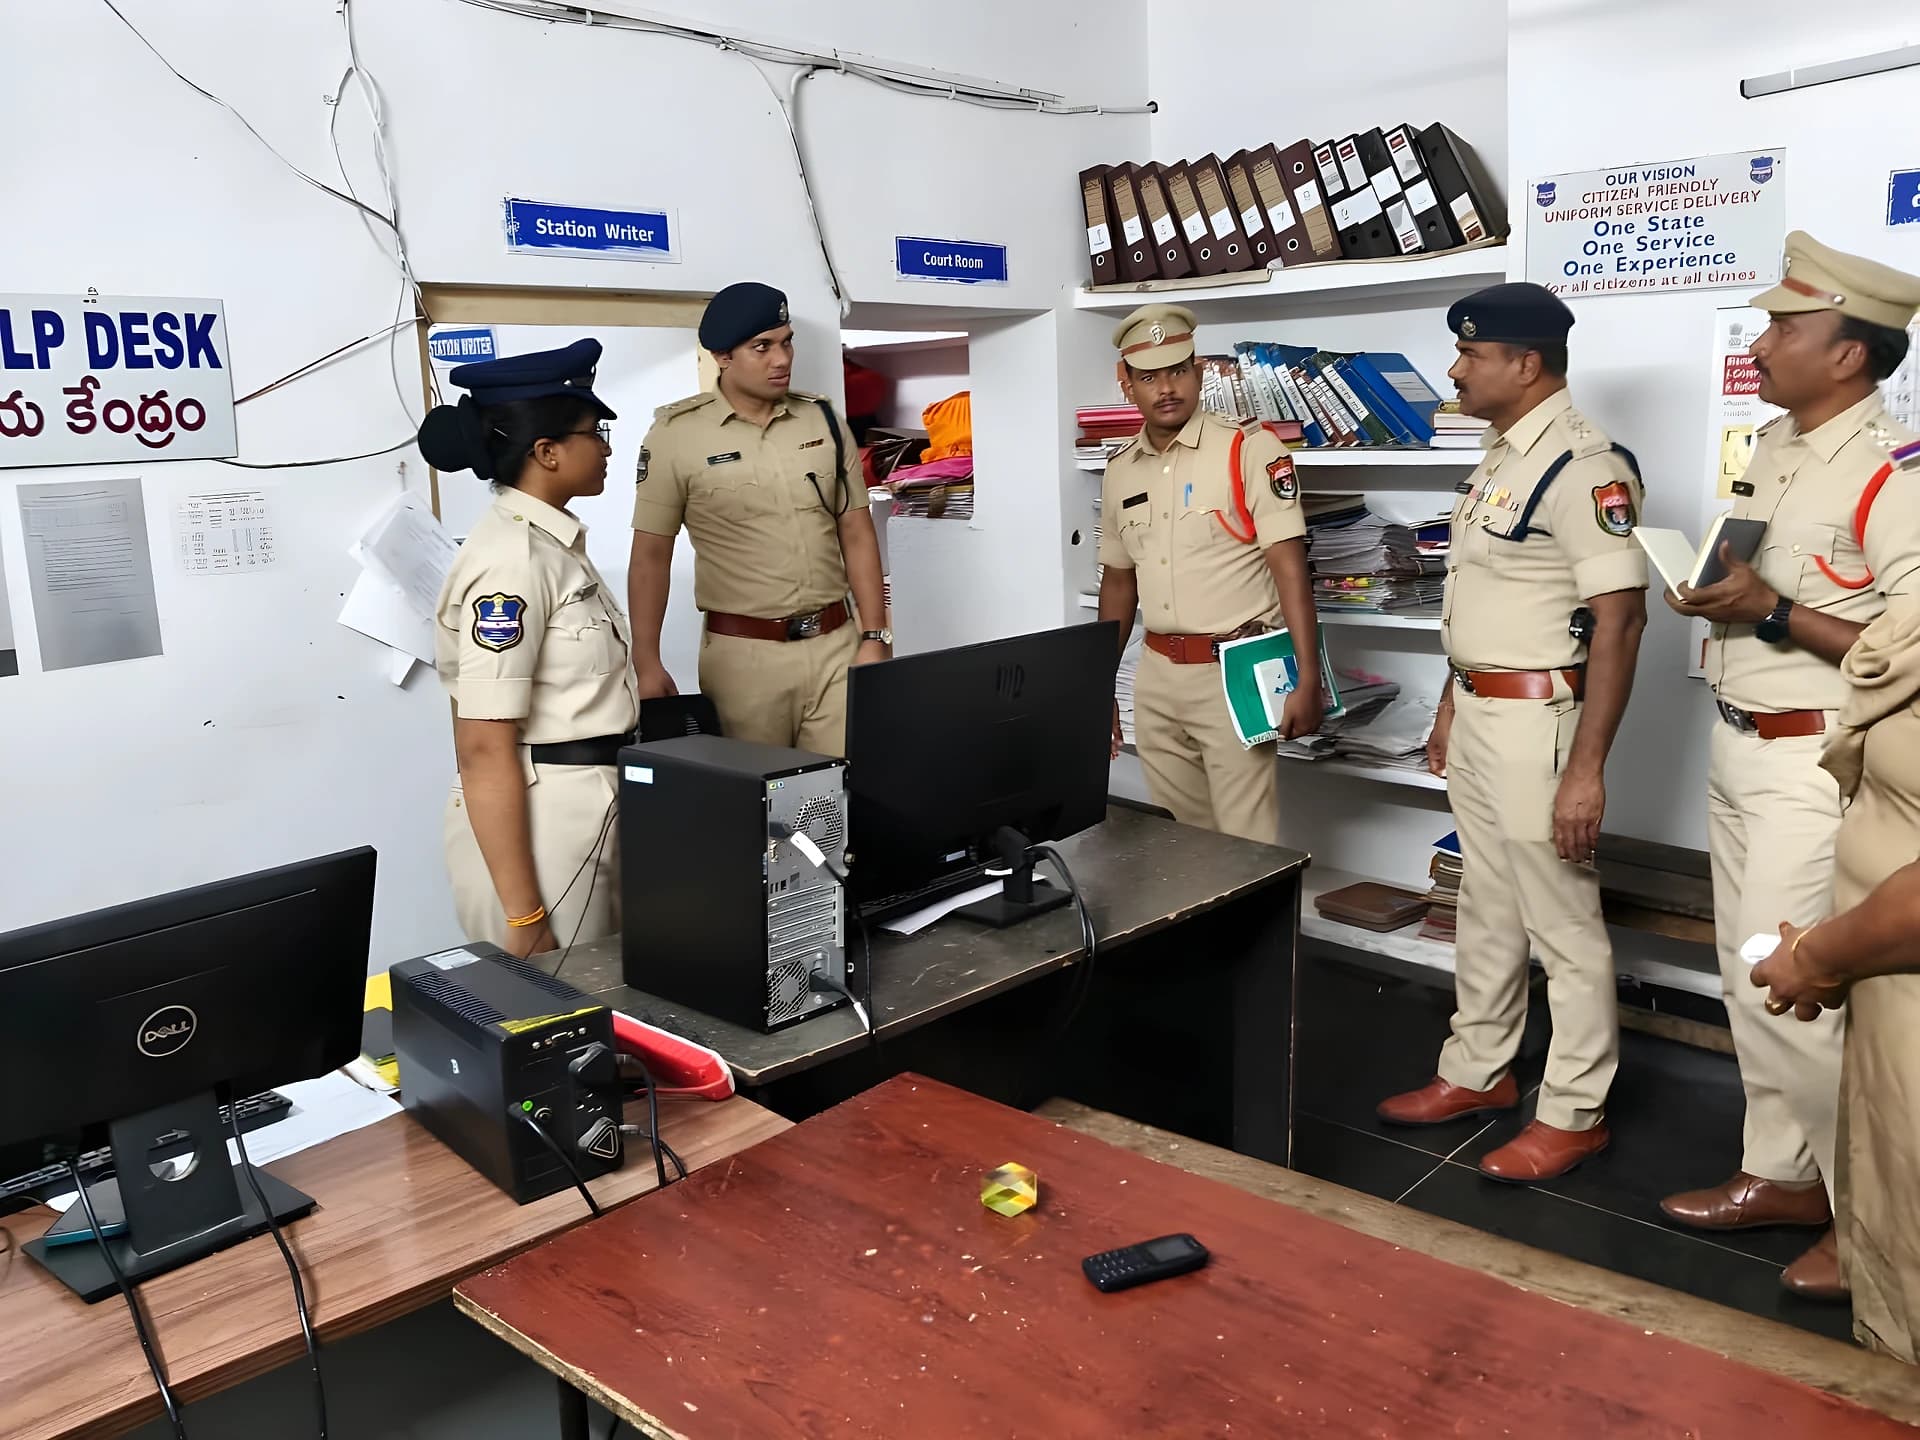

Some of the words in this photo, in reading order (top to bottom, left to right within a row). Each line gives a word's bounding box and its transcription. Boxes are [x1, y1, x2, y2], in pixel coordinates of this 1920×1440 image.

[1605, 171, 1638, 186] OUR
[1642, 165, 1696, 182] VISION
[1582, 187, 1639, 204] CITIZEN
[1648, 178, 1719, 197] FRIENDLY
[1544, 205, 1612, 223] UNIFORM
[1616, 198, 1679, 217] SERVICE
[1683, 189, 1761, 209] DELIVERY
[535, 218, 597, 239] Station
[604, 222, 654, 242] Writer
[1594, 220, 1635, 237] One
[1647, 215, 1705, 232] State
[1583, 240, 1624, 256] One
[1636, 231, 1715, 252] Service
[923, 251, 953, 267] Court
[955, 254, 984, 269] Room
[1563, 260, 1604, 277] One
[1616, 251, 1737, 275] Experience
[0, 309, 65, 370] LP
[83, 311, 223, 370] DESK
[62, 375, 207, 449] కేంద్రం
[144, 1020, 191, 1044] DELL
